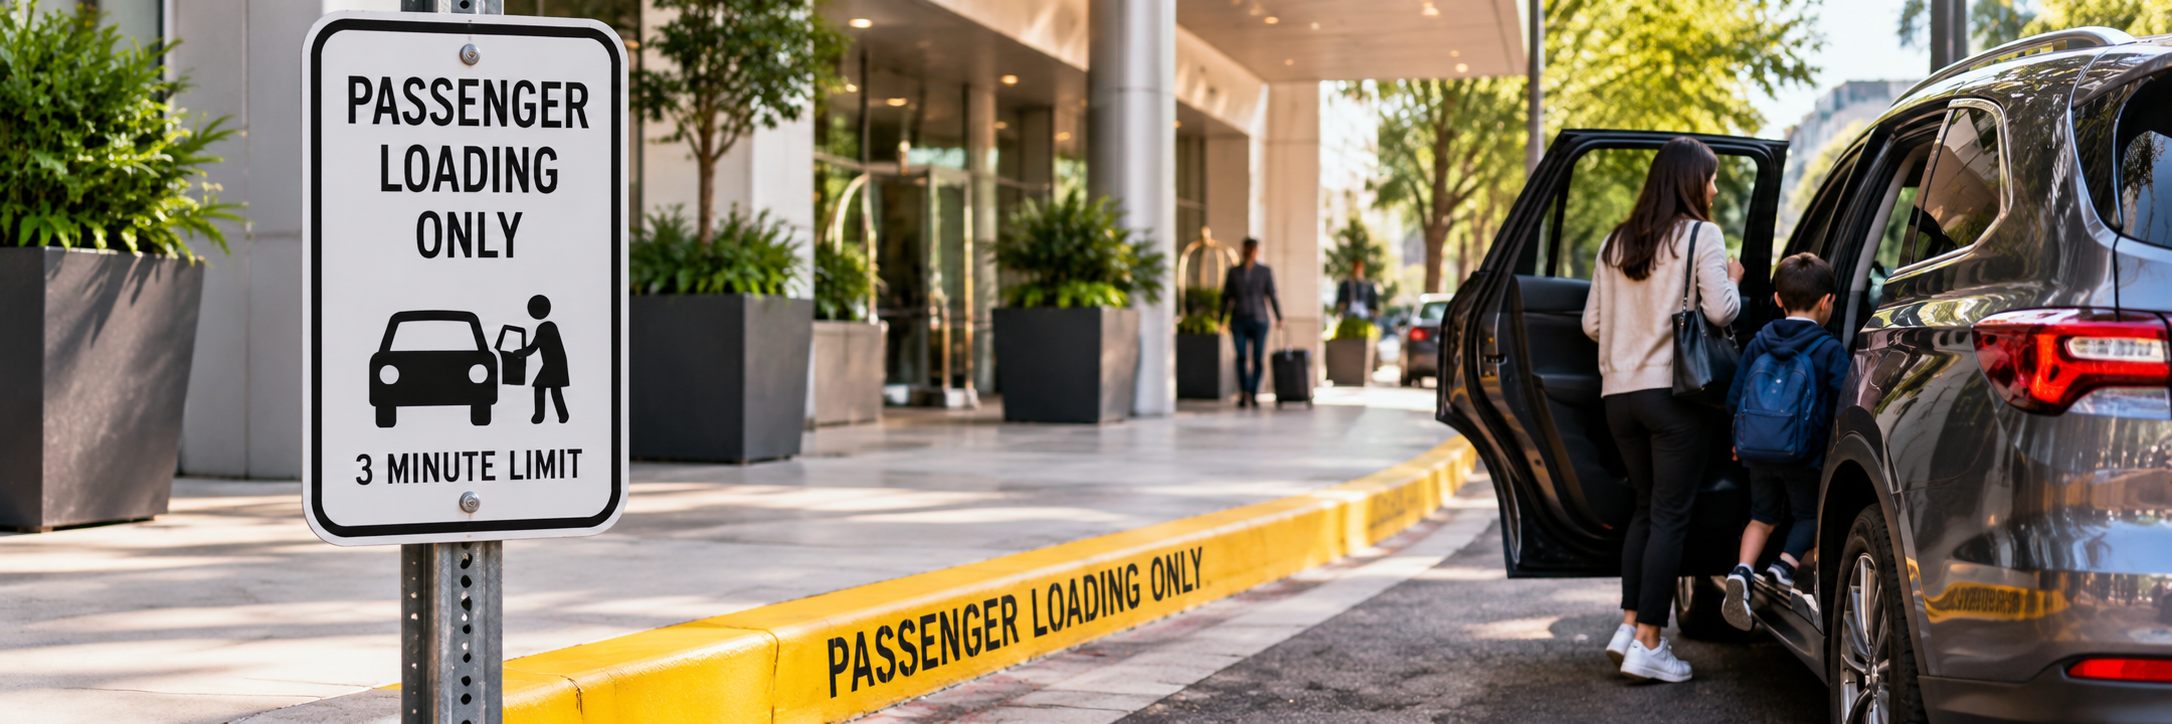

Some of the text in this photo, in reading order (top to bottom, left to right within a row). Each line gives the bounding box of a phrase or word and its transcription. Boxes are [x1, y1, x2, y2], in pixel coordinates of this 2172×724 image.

[347, 75, 589, 129] PASSENGER
[380, 144, 559, 194] LOADING
[416, 210, 523, 259] ONLY
[355, 448, 583, 486] 3 MINUTE LIMIT
[827, 546, 1203, 699] PASSENGER LOADING ONLY
